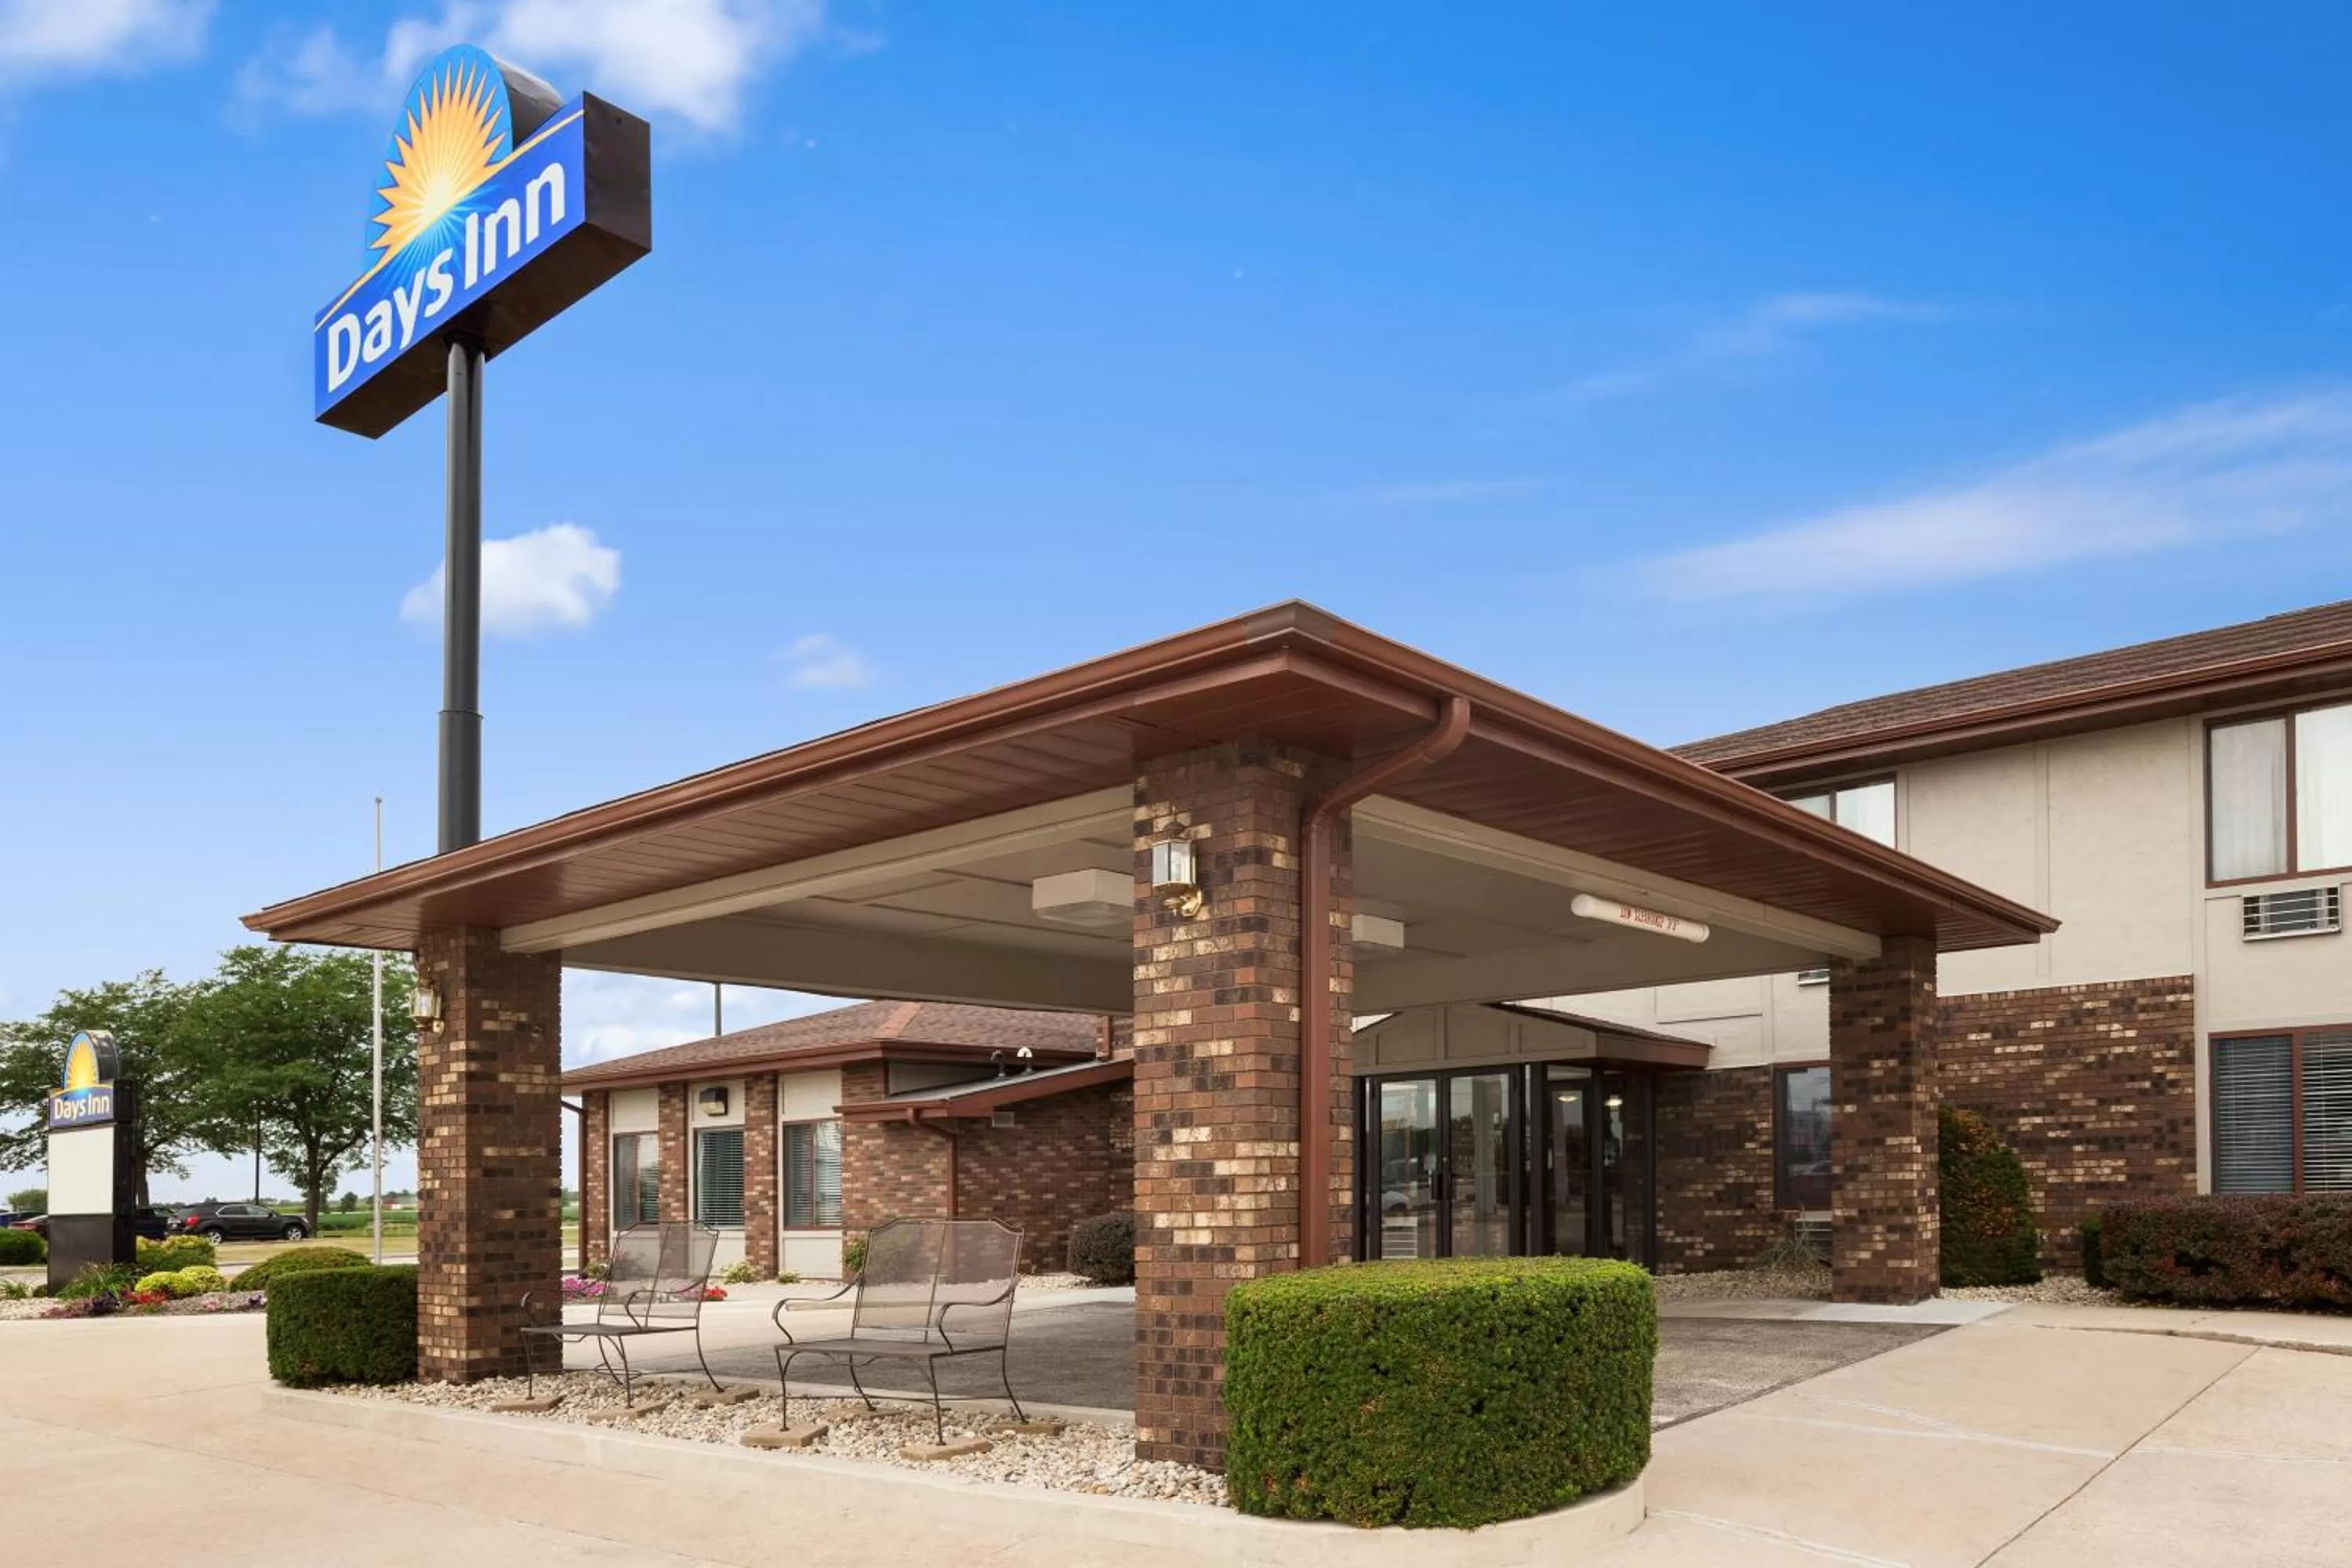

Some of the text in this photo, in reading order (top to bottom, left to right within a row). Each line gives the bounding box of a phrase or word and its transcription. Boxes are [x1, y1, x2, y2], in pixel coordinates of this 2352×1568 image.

[327, 162, 565, 393] Days Inn
[54, 1093, 109, 1121] Days Inn
